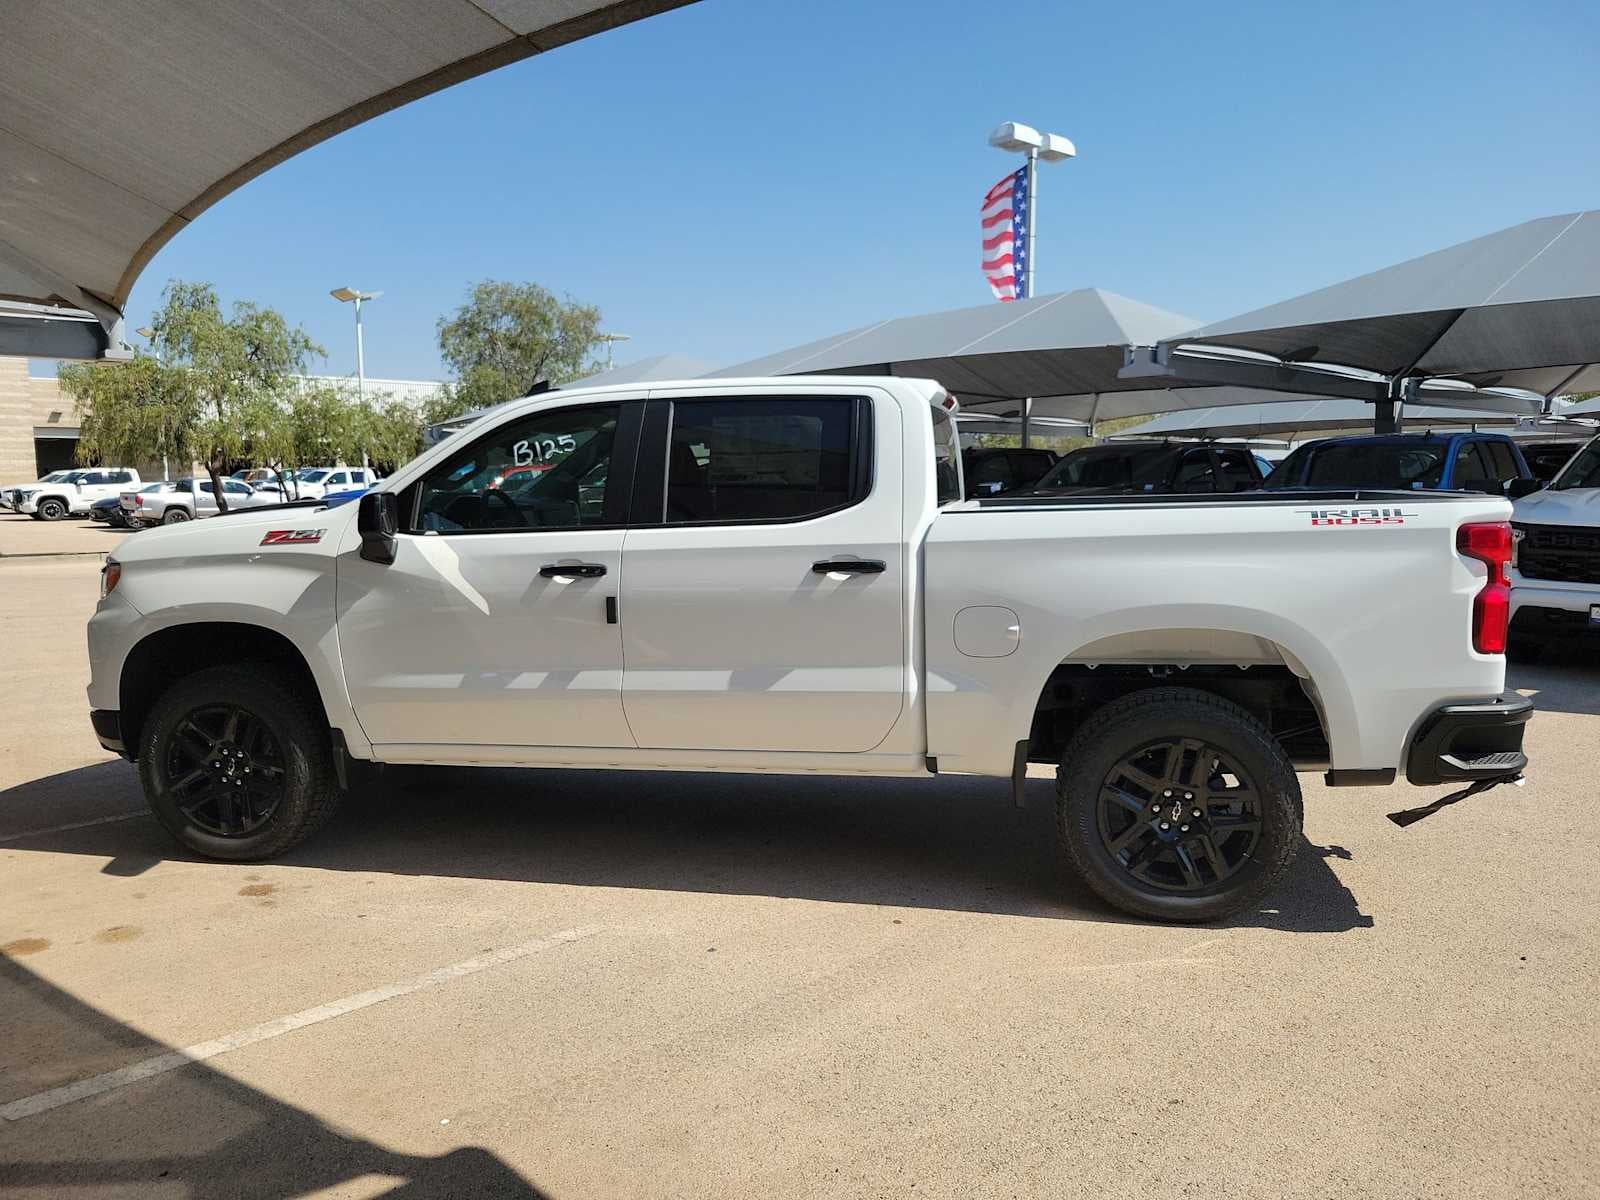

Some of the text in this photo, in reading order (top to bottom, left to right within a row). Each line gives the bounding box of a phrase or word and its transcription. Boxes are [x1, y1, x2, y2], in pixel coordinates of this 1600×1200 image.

[513, 434, 577, 466] B125
[1296, 508, 1418, 519] TRAIL
[1311, 517, 1404, 526] BOSS
[259, 529, 328, 546] Z71
